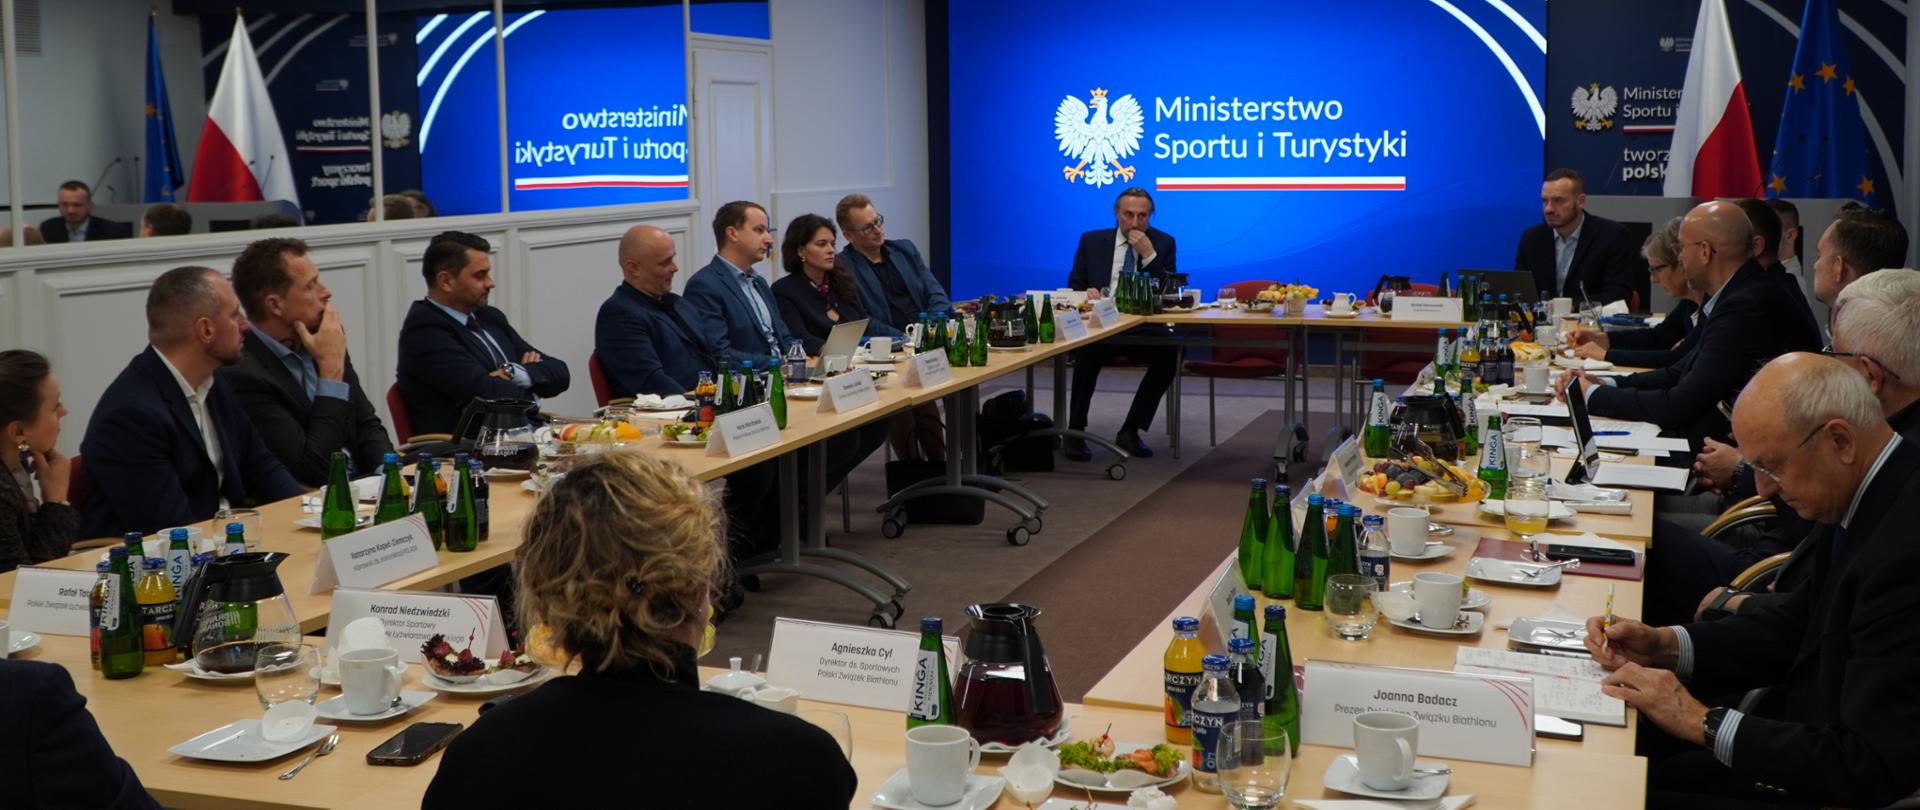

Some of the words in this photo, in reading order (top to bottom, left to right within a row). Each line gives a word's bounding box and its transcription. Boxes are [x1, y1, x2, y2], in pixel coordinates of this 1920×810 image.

[1624, 87, 1684, 100] Minister
[1155, 96, 1343, 122] Ministerstwo
[1623, 104, 1671, 119] Sportu
[1154, 132, 1248, 164] Sportu
[1257, 132, 1264, 158] i
[1273, 130, 1408, 164] Turystyki
[1624, 148, 1671, 162] tworz
[1622, 163, 1668, 181] polsk
[1468, 396, 1477, 424] KINGA
[1489, 434, 1498, 465] KINGA
[370, 604, 398, 614] Konrad
[405, 620, 437, 630] Sportowy
[831, 642, 877, 656] Agnieszka
[819, 656, 848, 667] Dyrektor
[860, 662, 901, 673] Sportowych
[817, 668, 838, 678] Polski
[838, 671, 866, 682] Związek
[866, 674, 899, 686] Biathlonu
[913, 657, 928, 711] KINGA
[1373, 690, 1415, 703] Joanna
[1417, 693, 1458, 707] Badacz
[1192, 714, 1223, 728] CZYN
[1412, 710, 1449, 724] Związku
[1450, 714, 1497, 728] Biathlonu
